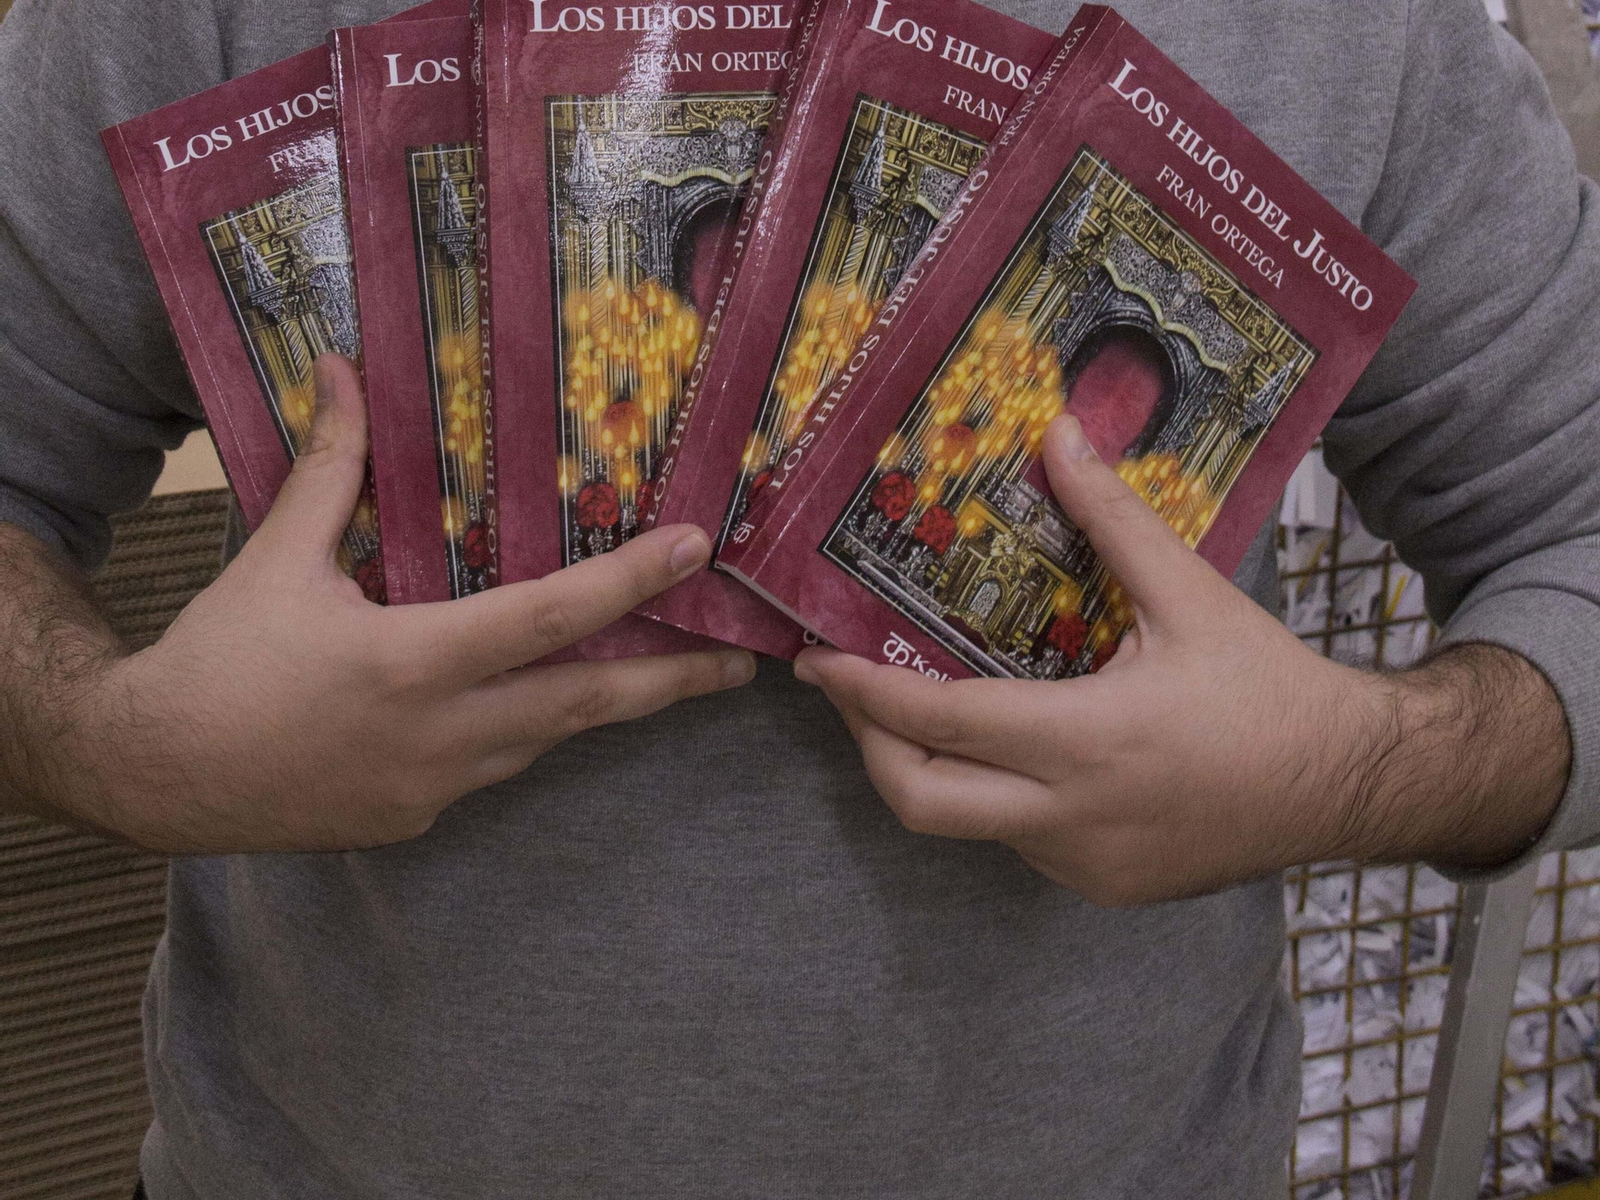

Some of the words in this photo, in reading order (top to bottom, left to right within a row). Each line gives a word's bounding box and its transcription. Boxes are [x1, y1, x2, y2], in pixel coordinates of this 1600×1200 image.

[383, 53, 461, 87] LOS
[614, 5, 716, 32] HIJOS
[725, 4, 792, 29] DEL
[940, 35, 1032, 91] HIJOS
[153, 125, 233, 172] LOS
[236, 84, 336, 142] HIJOS
[942, 85, 1007, 126] FRAN
[999, 100, 1035, 146] FRAN
[1034, 26, 1086, 95] ORTEGA
[1108, 59, 1170, 128] LOS
[1166, 117, 1244, 195] HIJOS
[1241, 184, 1295, 242] DEL
[1294, 228, 1374, 312] JUSTO
[1155, 164, 1212, 219] FRAN
[1210, 215, 1285, 290] ORTEGA
[646, 457, 674, 526] LOS
[671, 344, 710, 447] HIJOS
[734, 150, 773, 258] JUSTO
[769, 431, 815, 490] LOS
[812, 334, 880, 425] HIJOS
[878, 267, 925, 328] DEL
[926, 170, 989, 262] JUSTO
